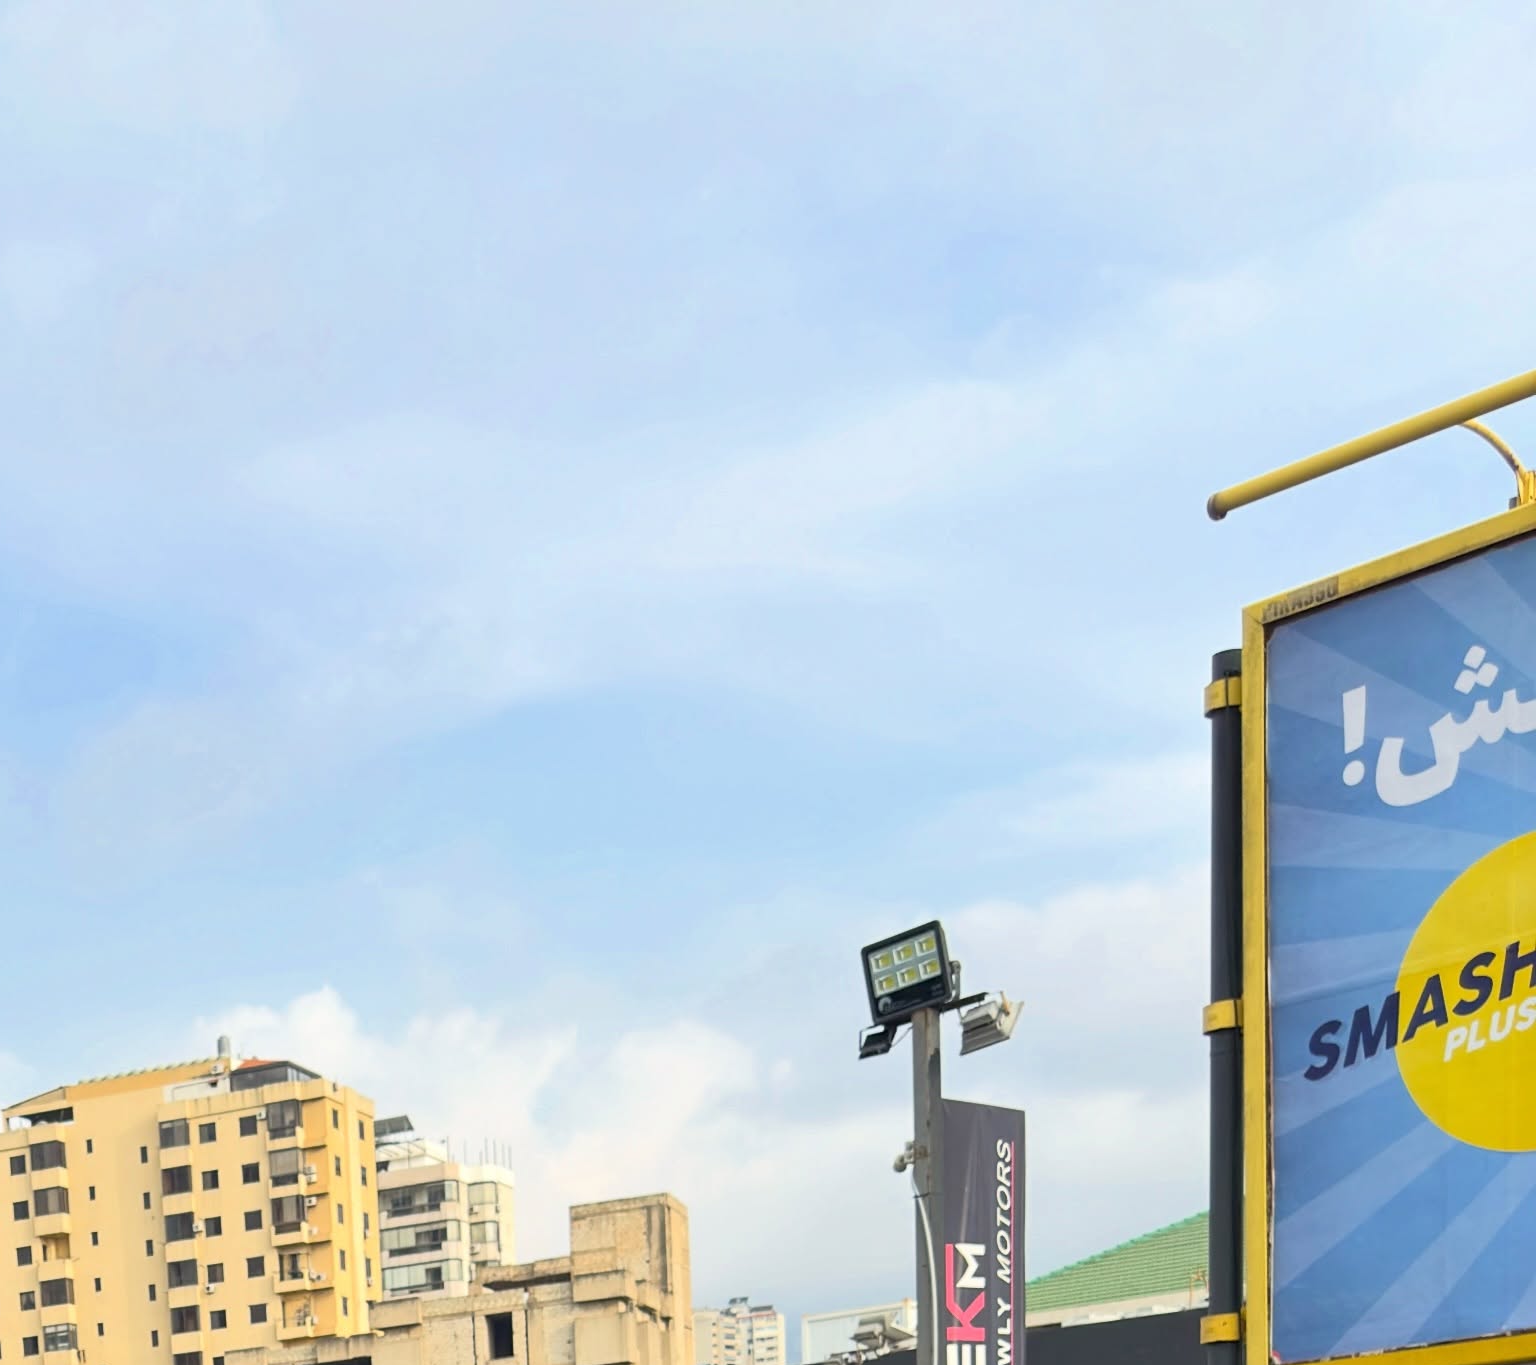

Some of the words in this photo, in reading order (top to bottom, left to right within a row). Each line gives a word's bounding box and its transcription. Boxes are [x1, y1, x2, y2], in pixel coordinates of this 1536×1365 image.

[1304, 941, 1536, 1082] SMASH
[1443, 996, 1536, 1062] PLUS
[996, 1138, 1012, 1284] MOTORS
